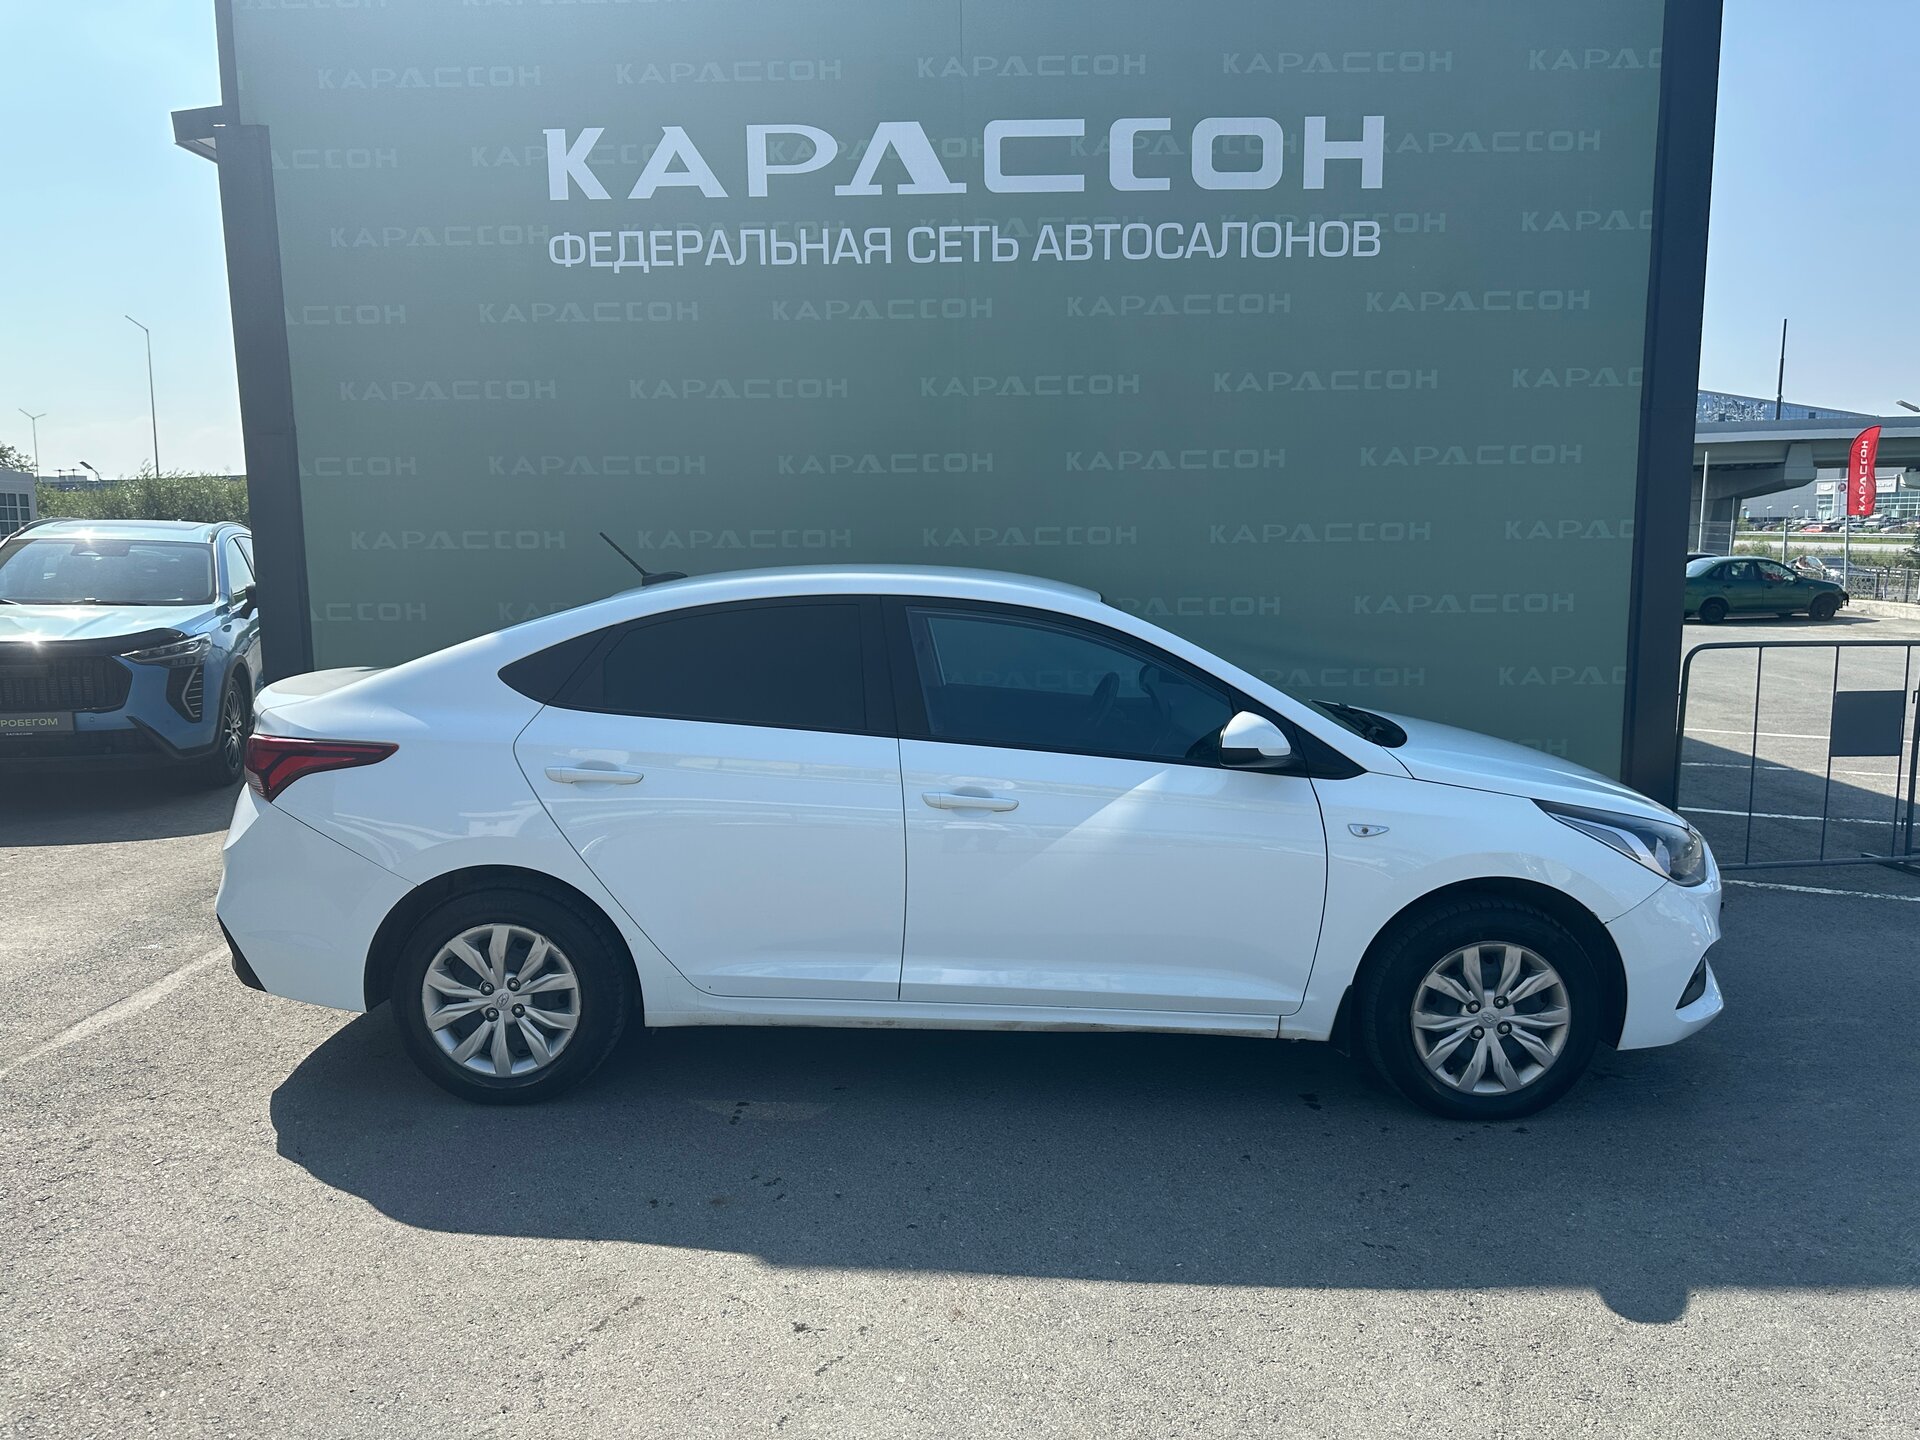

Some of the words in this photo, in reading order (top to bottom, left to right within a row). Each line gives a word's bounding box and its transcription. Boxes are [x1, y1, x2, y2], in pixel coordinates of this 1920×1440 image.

[1528, 47, 1661, 71] КАРЛ
[1521, 209, 1653, 232] КАРЛ
[548, 227, 892, 274] ФЕДЕРАЛЬНАЯ
[907, 224, 1019, 264] СЕТЬ
[1031, 220, 1382, 262] АВТОСАЛОНОВ
[1512, 366, 1643, 388] КАРЛС
[1505, 519, 1634, 541] КАРЛС
[1499, 665, 1626, 687] КАРЛС
[0, 718, 58, 728] РОБЕГОМ
